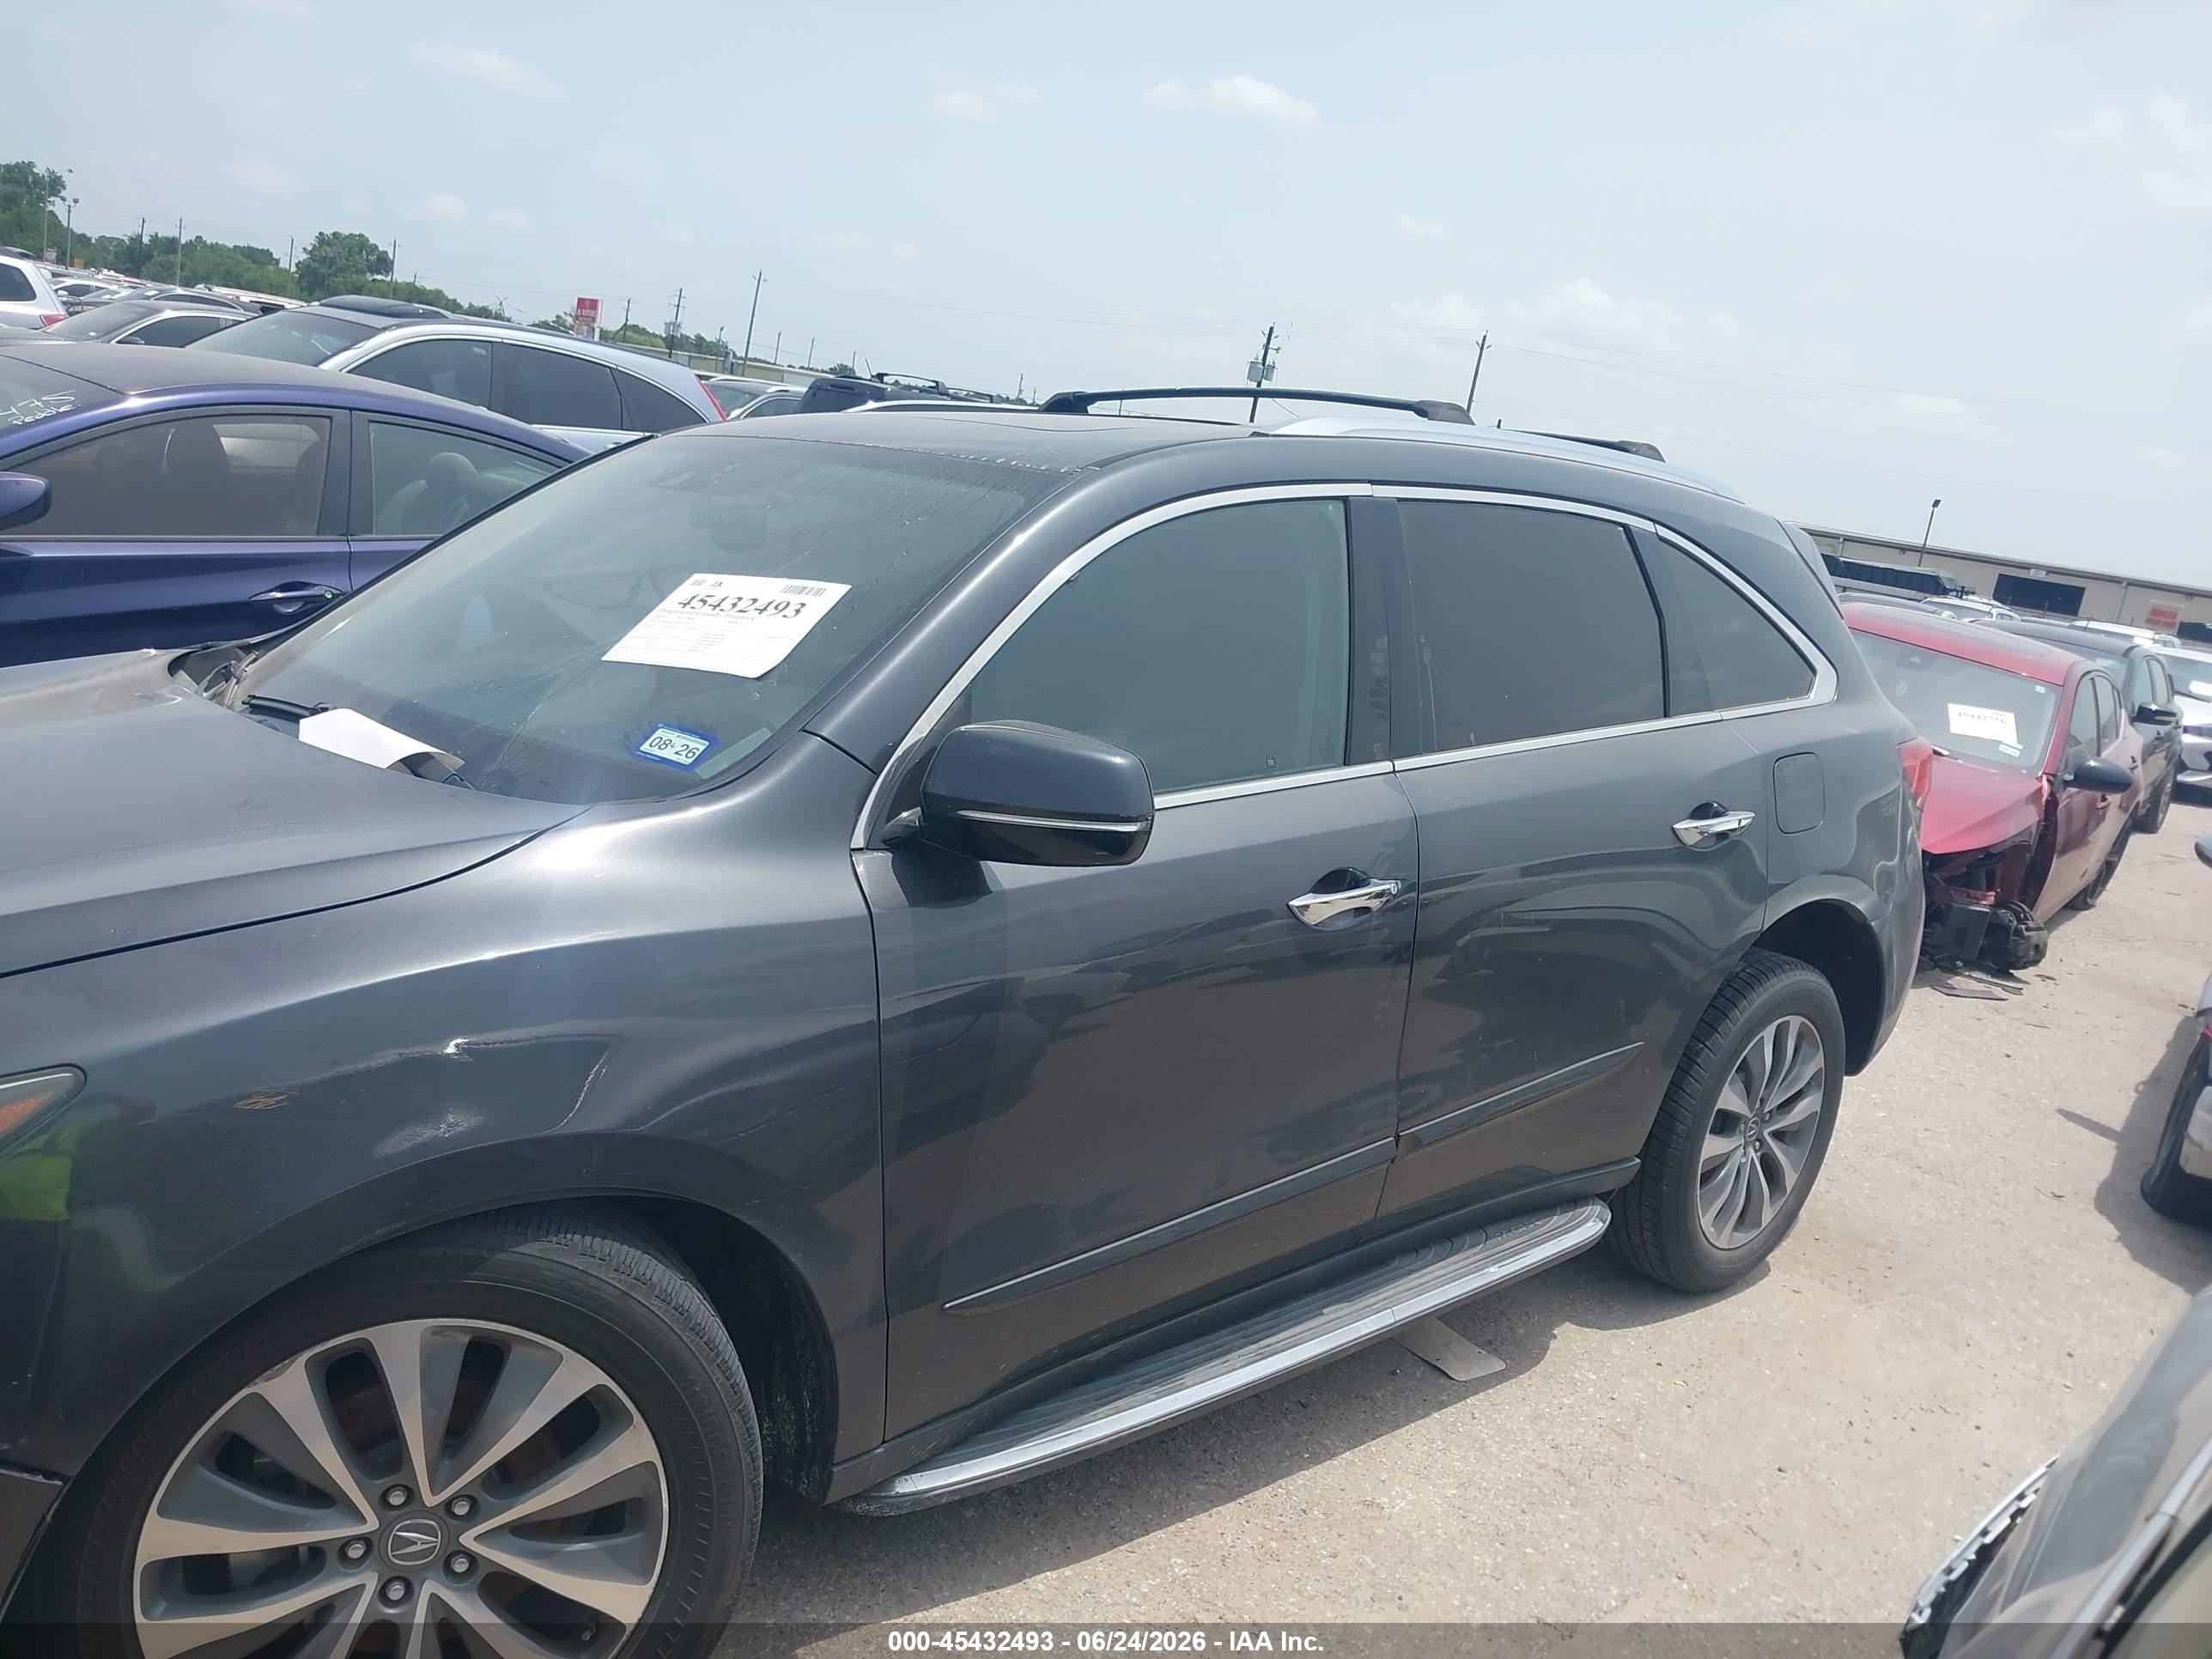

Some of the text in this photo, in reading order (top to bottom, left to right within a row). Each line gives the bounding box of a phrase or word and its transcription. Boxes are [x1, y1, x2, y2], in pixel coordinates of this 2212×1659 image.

[678, 593, 807, 619] 45432493
[649, 736, 672, 750] 08
[673, 744, 700, 759] 26
